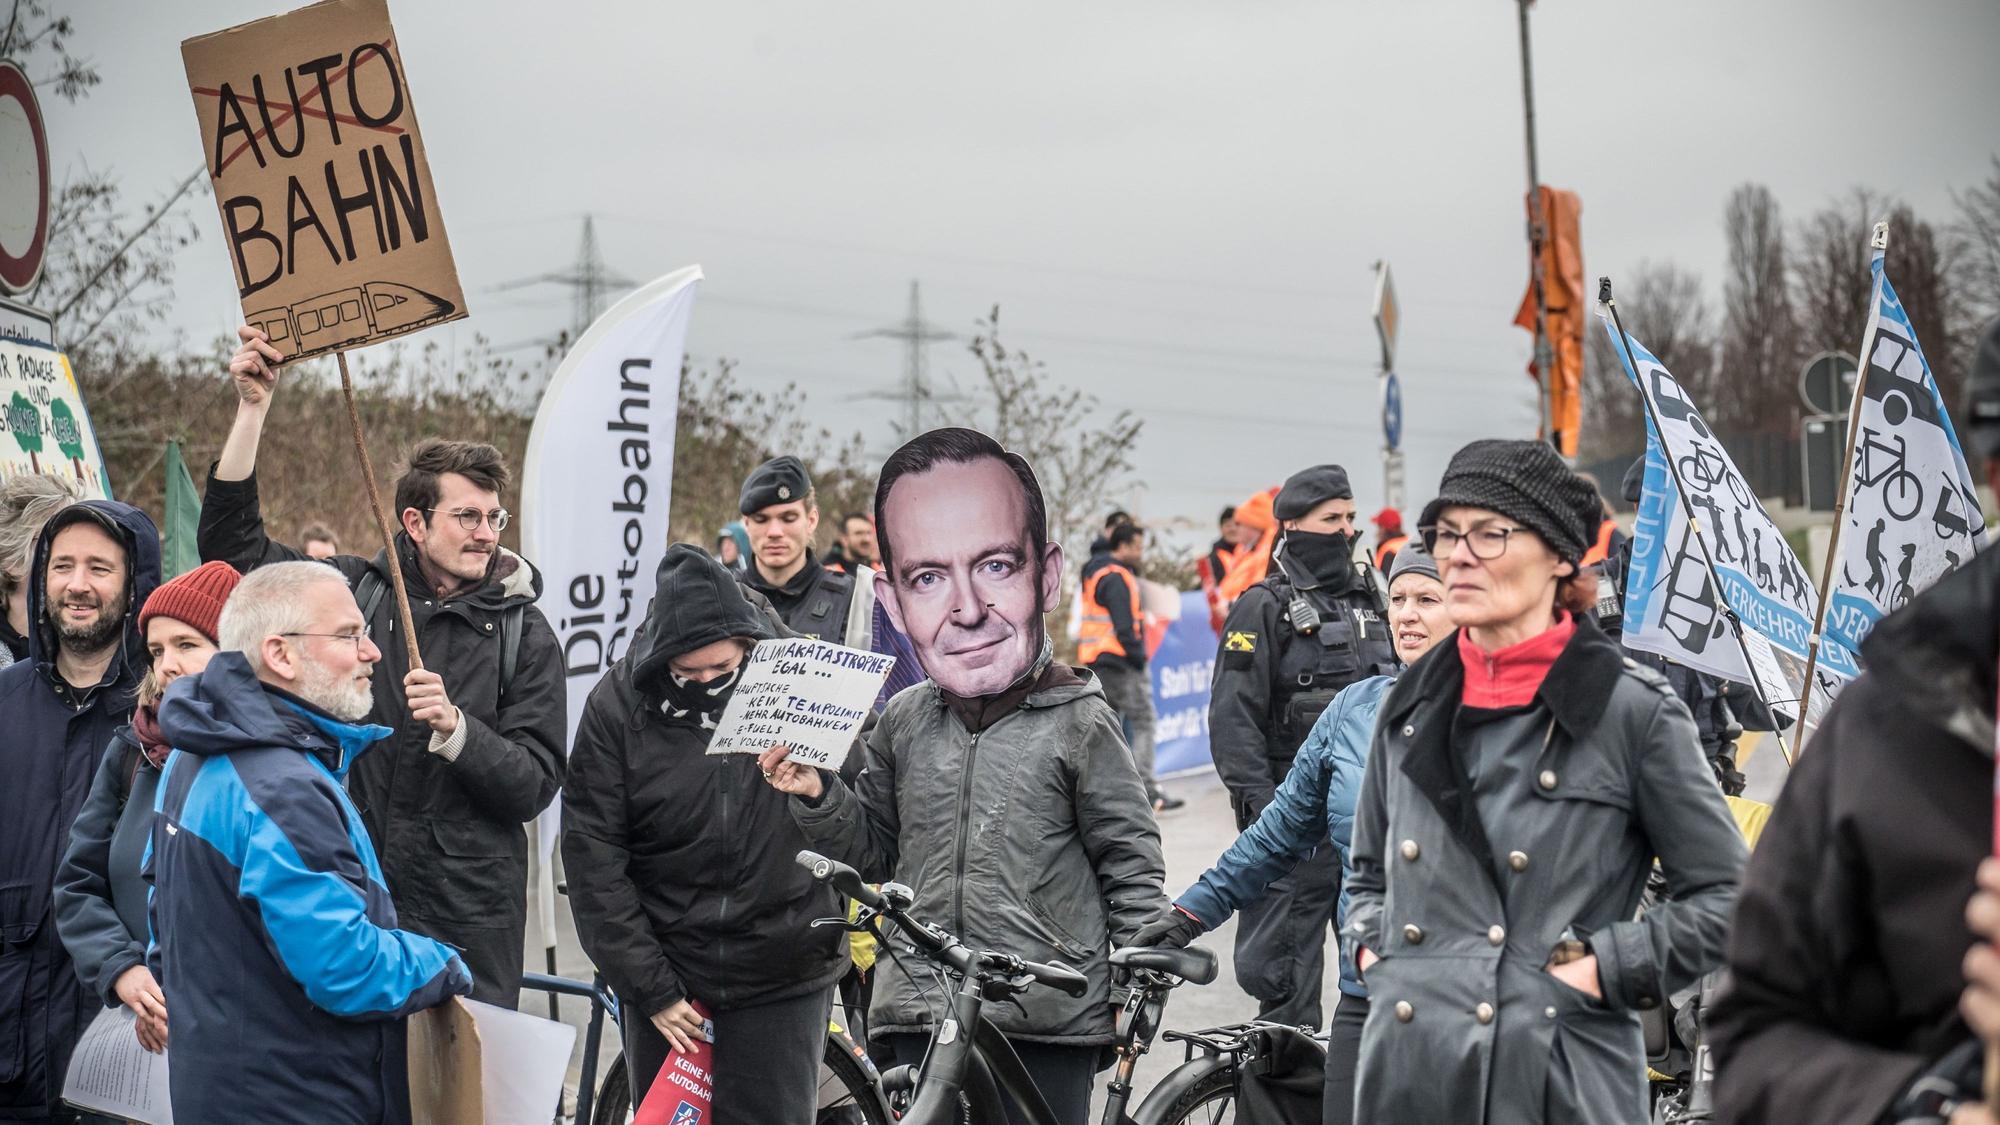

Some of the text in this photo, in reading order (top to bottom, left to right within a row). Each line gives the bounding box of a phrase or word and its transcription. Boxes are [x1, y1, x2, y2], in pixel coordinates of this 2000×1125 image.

[214, 42, 404, 178] AUTO
[223, 134, 429, 296] BAHN
[16, 352, 57, 384] RADWEGE
[28, 385, 51, 407] UND
[606, 357, 653, 668] Autobahn
[561, 574, 605, 679] Die
[1830, 604, 1875, 644] VER
[772, 660, 807, 675] EGAL
[735, 682, 791, 696] HAUPTSACHE
[769, 708, 853, 731] AUTOBAHNEN
[787, 695, 864, 720] TEMPOLIMIT
[715, 736, 734, 748] MFG
[674, 1055, 704, 1079] KEINE
